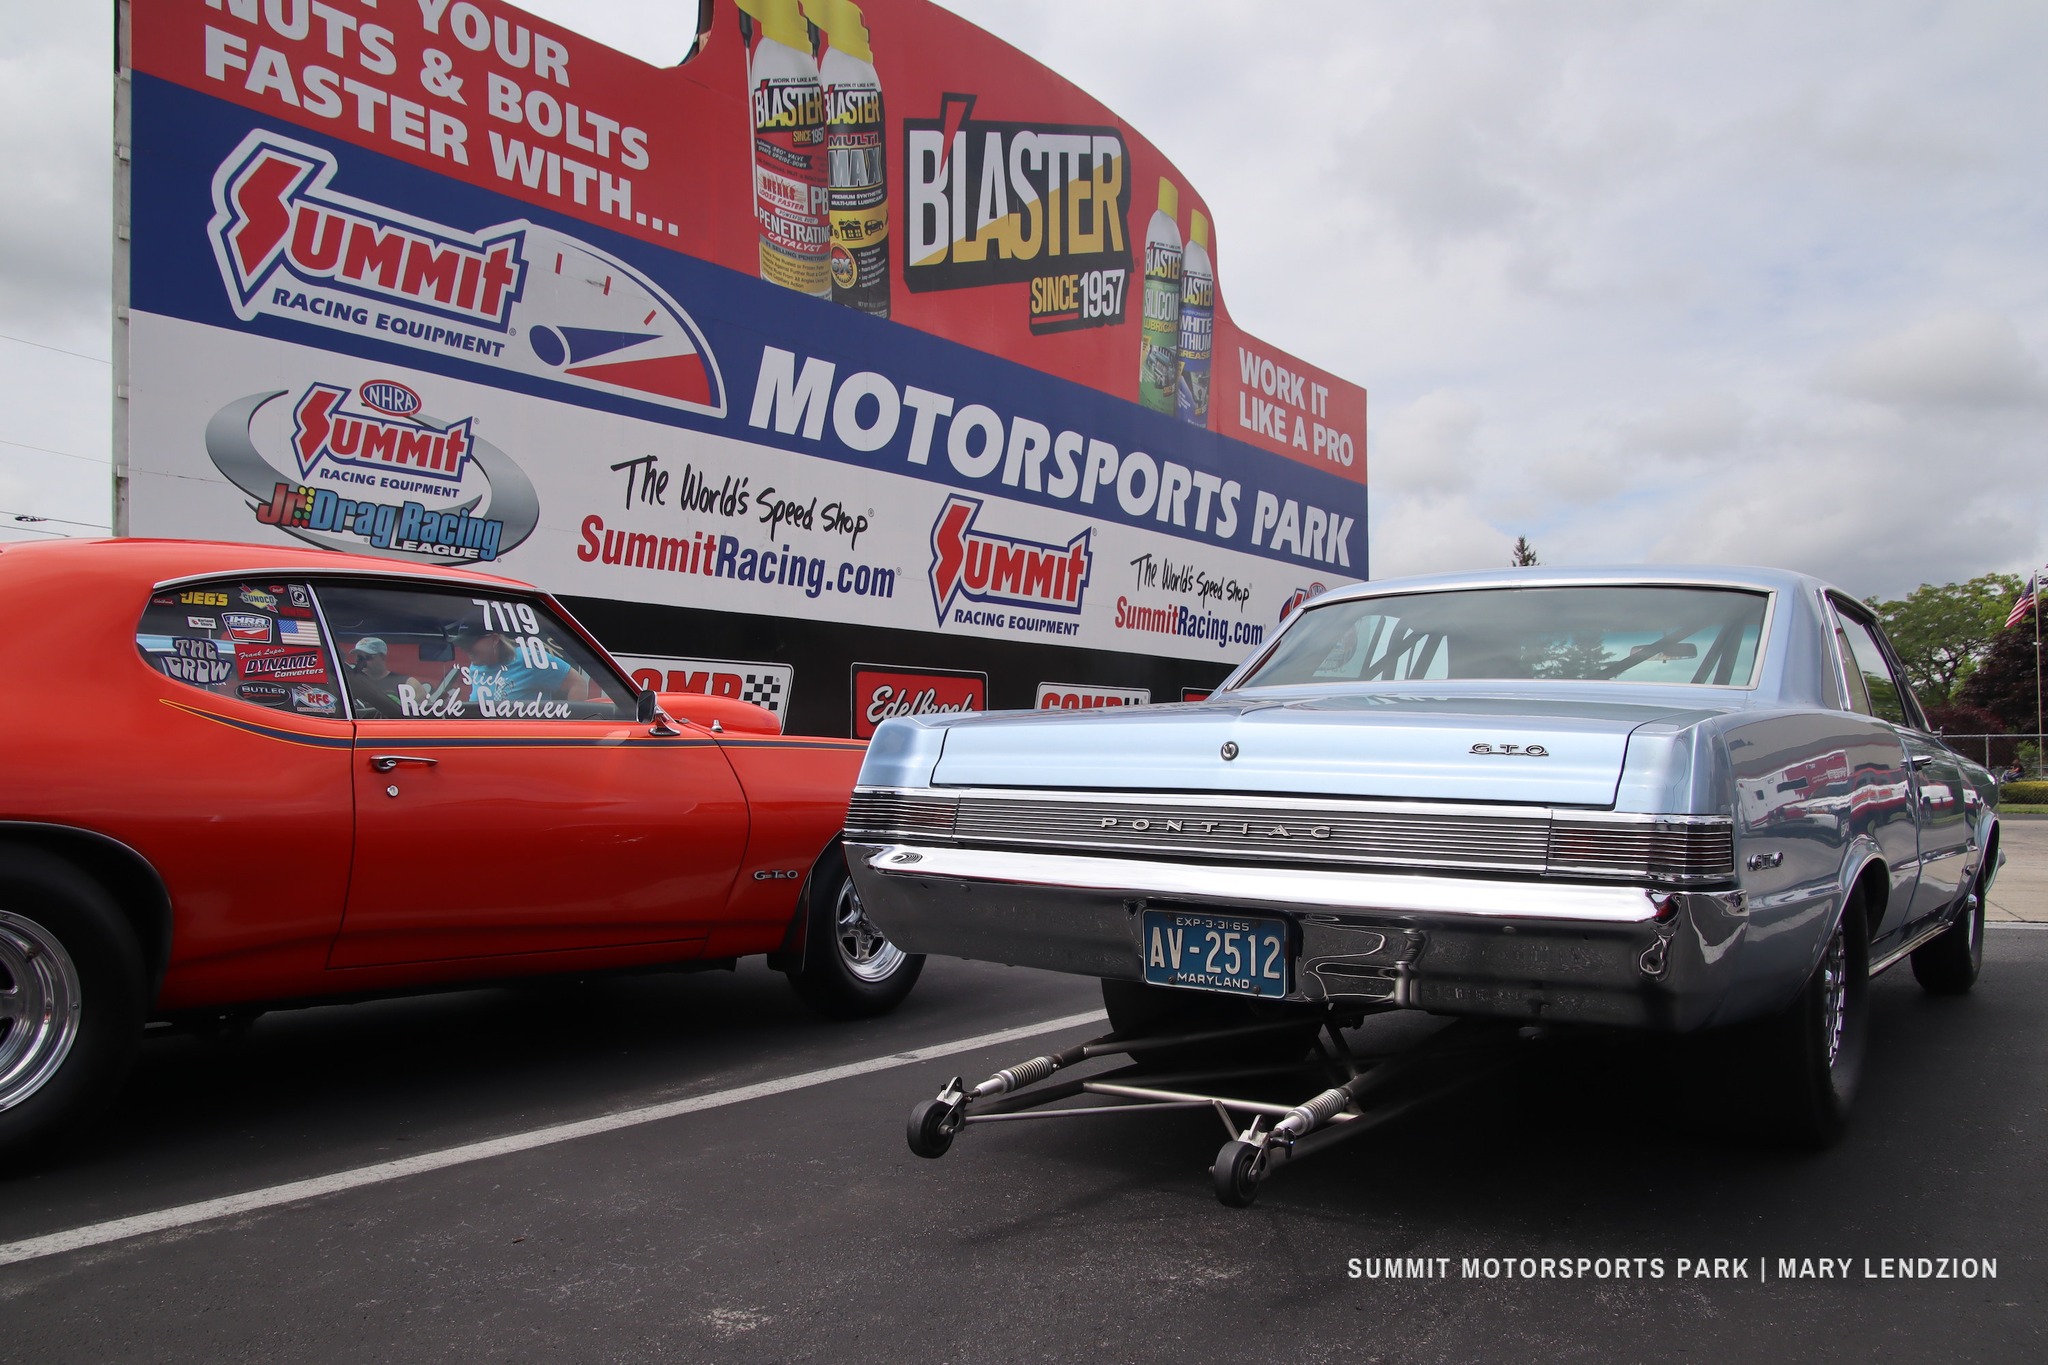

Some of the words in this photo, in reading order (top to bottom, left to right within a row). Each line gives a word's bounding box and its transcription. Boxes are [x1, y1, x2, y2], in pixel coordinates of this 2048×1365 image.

[416, 0, 570, 87] YOUR
[205, 24, 469, 166] FASTER
[420, 48, 467, 106] &
[487, 71, 650, 170] BOLTS
[793, 130, 811, 142] SINCE
[829, 134, 879, 147] MULTI
[829, 148, 884, 188] MAX
[762, 175, 796, 201] BREAKS
[777, 198, 805, 212] FASTER
[767, 231, 822, 252] CATALYST
[1031, 274, 1079, 314] SINCE
[1079, 269, 1125, 318] 1957
[272, 287, 368, 326] RACING
[375, 312, 505, 358] EQUIPMENT
[1239, 346, 1306, 411] WORK
[1311, 382, 1329, 419] IT
[368, 384, 418, 412] NHRA
[1239, 390, 1287, 443] LIKE
[1292, 415, 1308, 451] A
[1313, 422, 1354, 467] PRO
[749, 345, 1241, 539] MOTORSPORTS
[1251, 490, 1355, 568] PARK
[319, 467, 376, 488] RACING
[380, 477, 460, 498] EQUIPMENT
[610, 454, 669, 511] The
[680, 463, 749, 517] World's
[756, 487, 817, 541] Speed
[820, 501, 868, 551] Shop
[308, 488, 397, 548] Drag
[398, 501, 504, 562] Racing
[390, 522, 480, 559] LEAGUE
[577, 514, 896, 599] SummitRacing.com
[1130, 553, 1158, 591] The
[1162, 557, 1194, 593] World's
[1196, 571, 1225, 609] Speed
[1226, 579, 1250, 613] Shop
[180, 591, 229, 607] JEG'S
[242, 593, 275, 606] SUNOCO
[229, 615, 266, 626] IHRA
[471, 599, 540, 635] 7119
[954, 608, 1005, 628] RACING
[1008, 615, 1080, 636] EQUIPMENT
[1115, 595, 1263, 648] SummitRacing.com
[175, 639, 217, 660] THE
[239, 651, 262, 660] Frank
[164, 656, 232, 683] CROW
[244, 654, 318, 674] DYNAMIC
[274, 668, 324, 678] Converters
[241, 685, 286, 695] BUTLER
[307, 693, 330, 705] RFC
[398, 683, 465, 717] Rick
[477, 686, 571, 718] Garden
[1470, 742, 1549, 757] GTO
[1100, 817, 1332, 839] PONTIAC
[754, 869, 799, 880] GTO
[1150, 926, 1281, 979] AV-2512
[1176, 972, 1250, 990] MARYLAND
